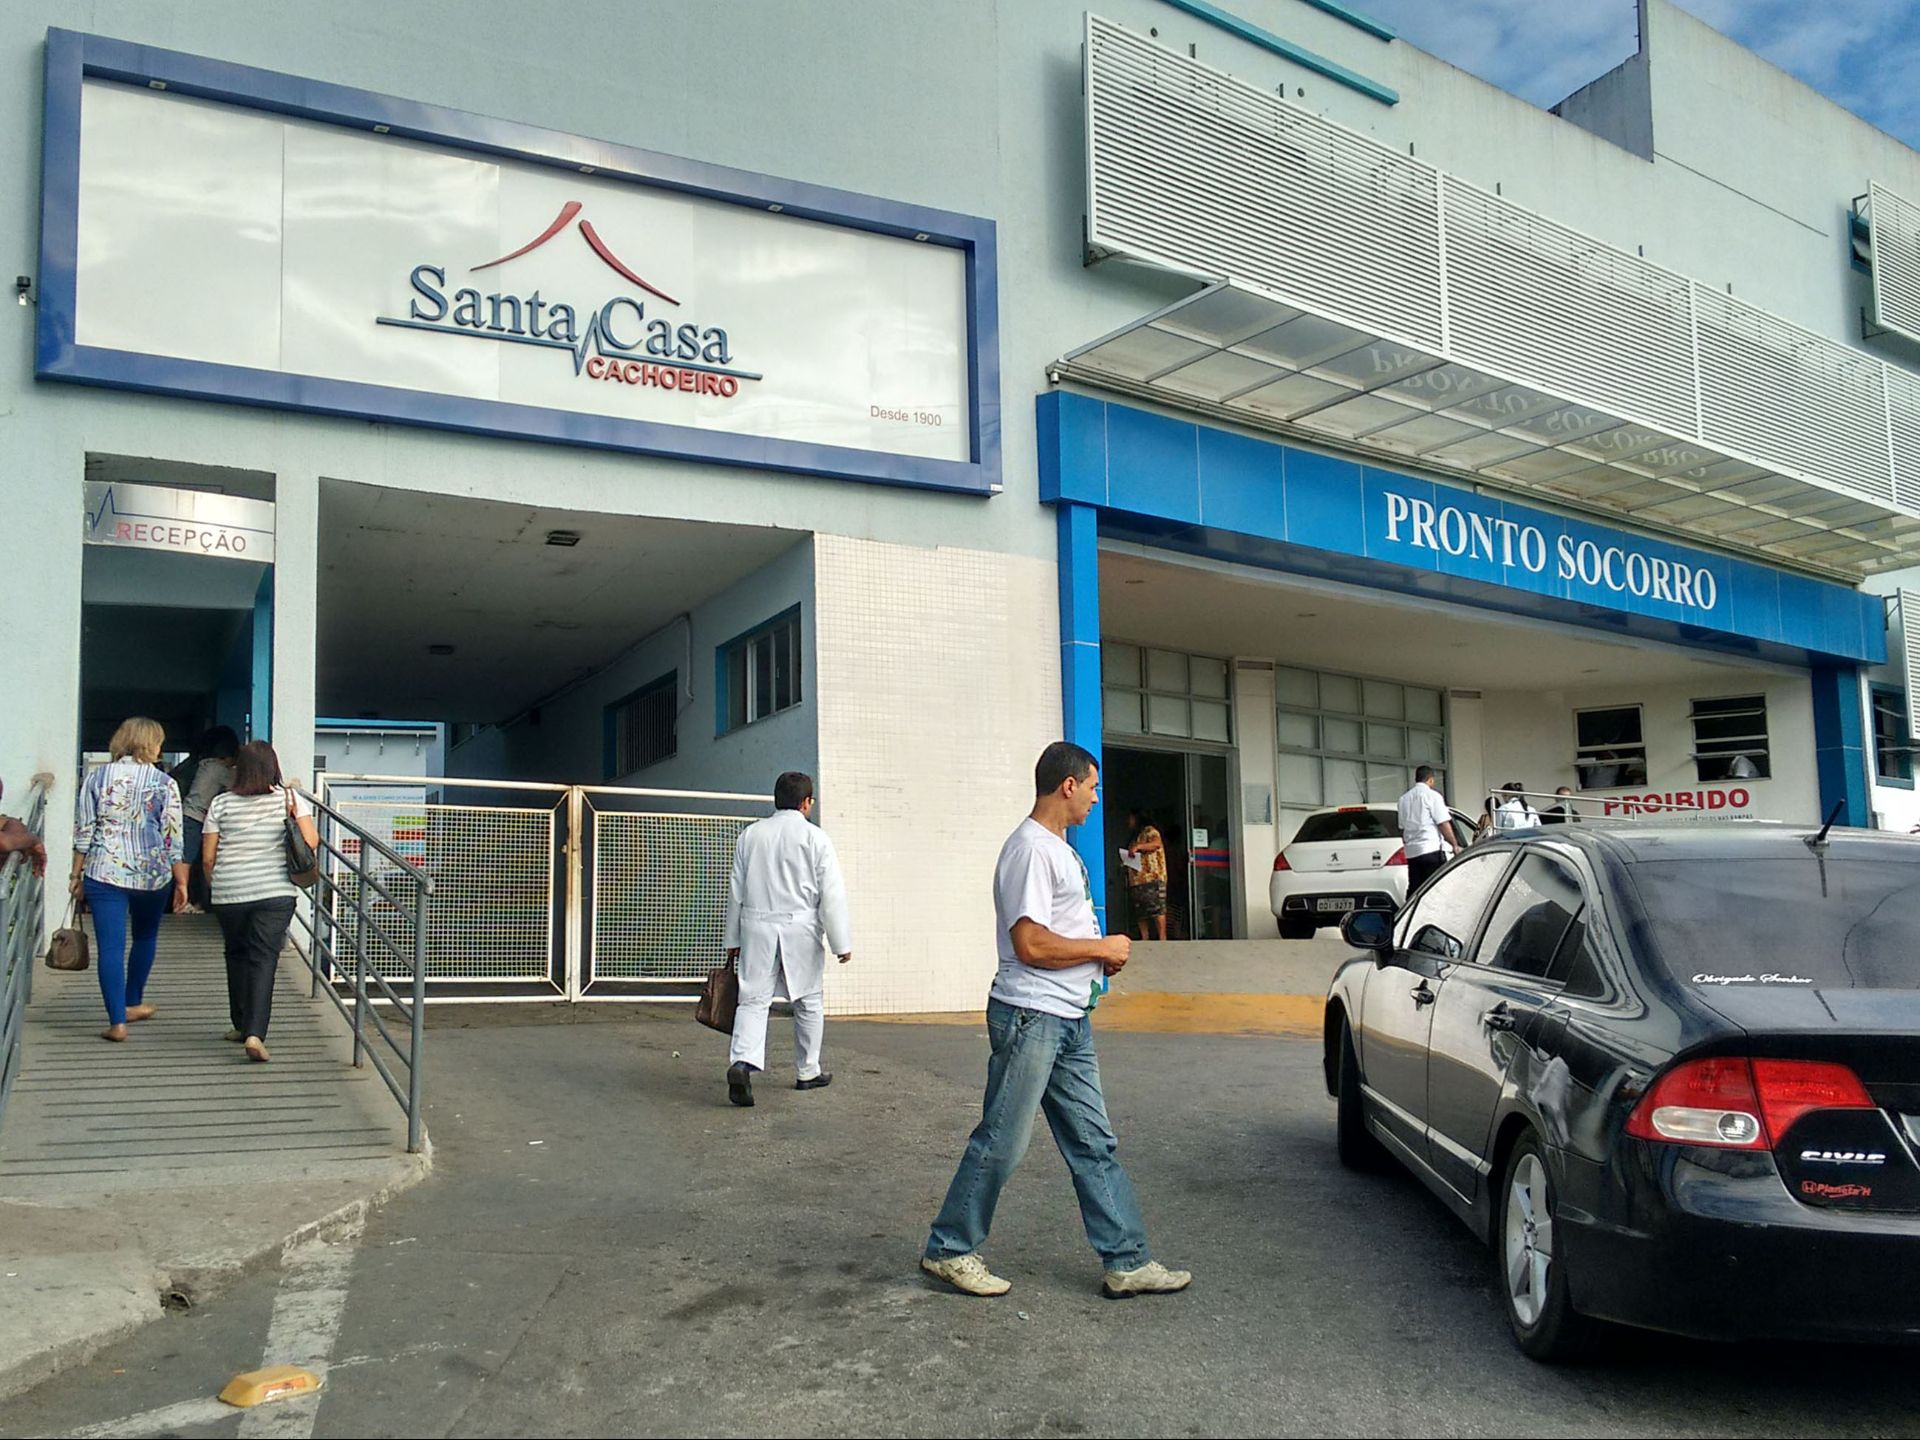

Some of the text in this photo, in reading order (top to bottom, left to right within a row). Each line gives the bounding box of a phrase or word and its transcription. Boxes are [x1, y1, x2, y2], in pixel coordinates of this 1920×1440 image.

[410, 264, 733, 365] Santa Casa
[587, 357, 739, 398] CACHOEIRO
[870, 405, 942, 426] Desde 1900
[116, 522, 247, 553] RECEPÇÃO
[1383, 491, 1717, 610] PRONTO SOCORRO
[1603, 788, 1750, 816] PROIBIDO
[1800, 1150, 1886, 1164] CIVIC
